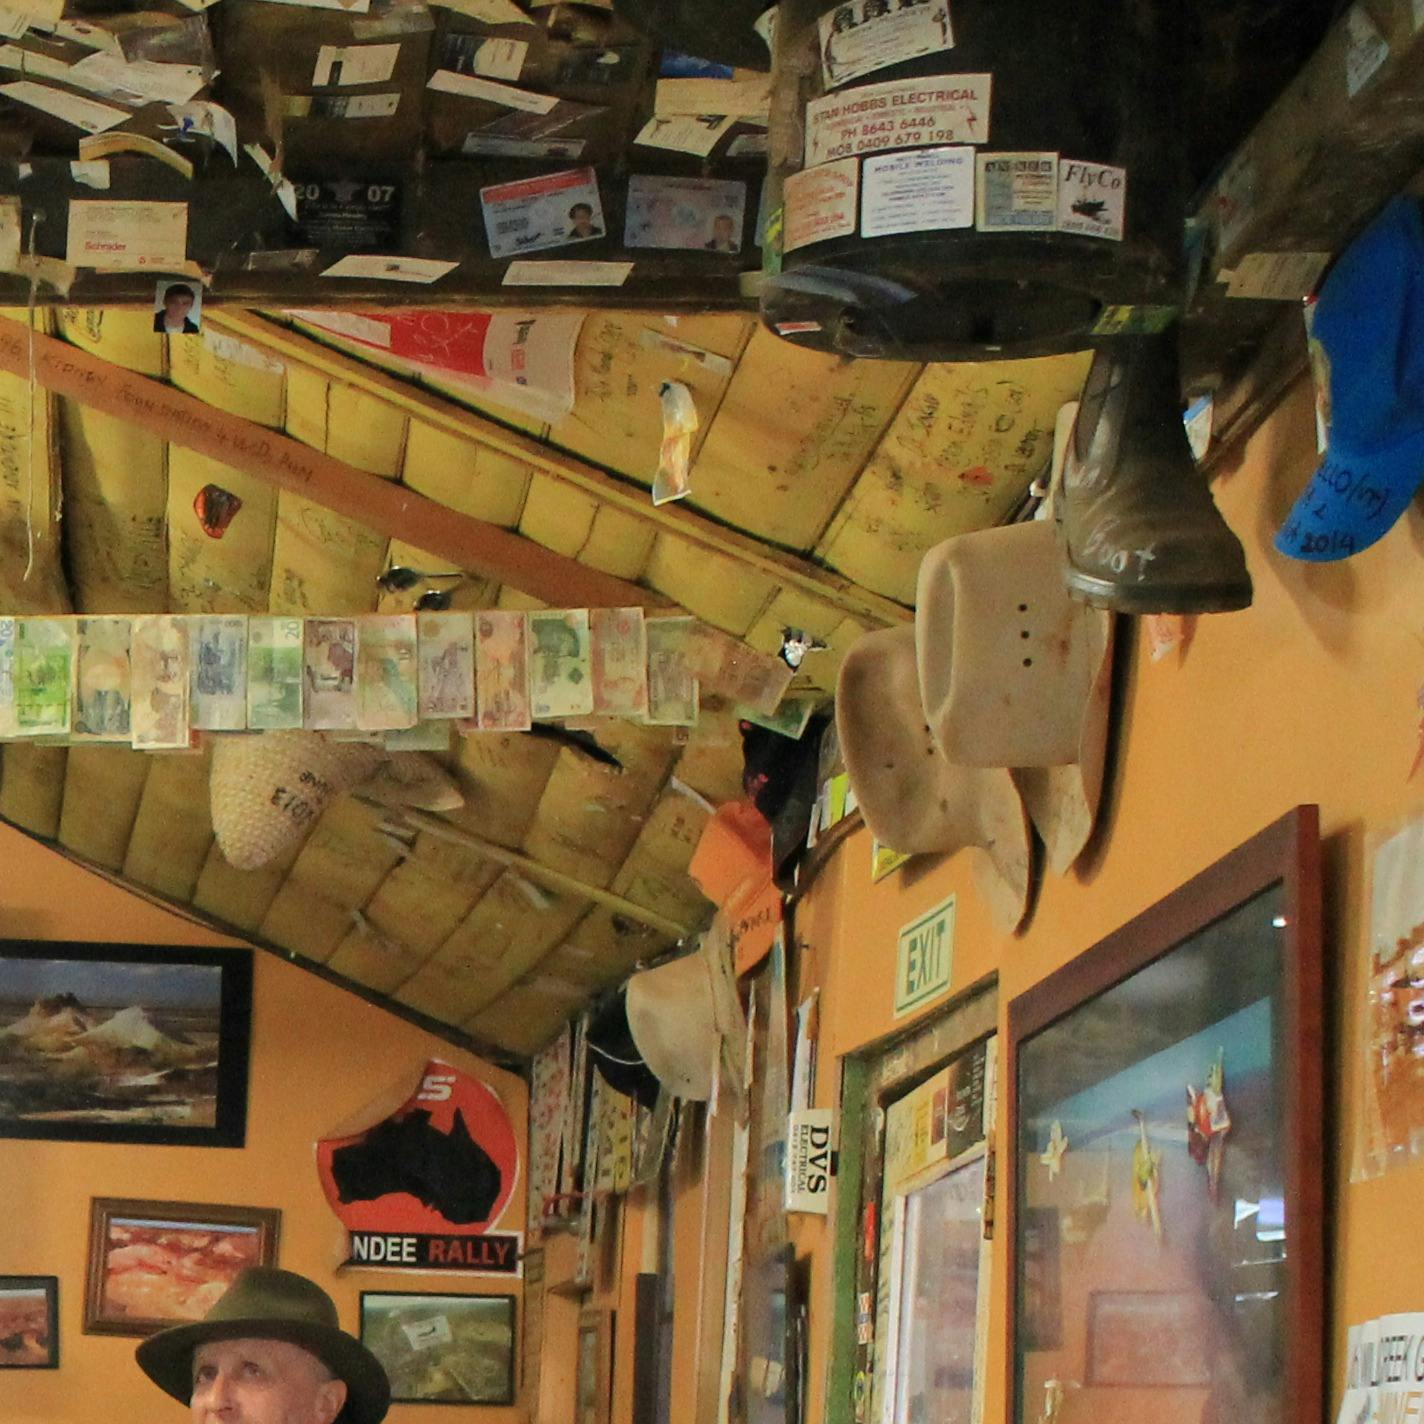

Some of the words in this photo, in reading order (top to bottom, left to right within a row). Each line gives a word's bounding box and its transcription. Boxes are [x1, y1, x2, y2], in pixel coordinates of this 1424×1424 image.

[892, 88, 978, 107] ELECTRICAL
[840, 128, 858, 140] PH
[862, 120, 895, 136] 8643
[900, 116, 936, 130] 6446
[857, 136, 891, 151] 0409
[894, 132, 922, 147] 679
[928, 129, 954, 143] 198
[1064, 163, 1121, 190] FlyCo
[368, 185, 394, 202] 07
[906, 919, 947, 996] EXIT
[797, 1124, 809, 1193] ELECTRICAL
[807, 1125, 830, 1194] DVS
[428, 1239, 509, 1265] RALLY
